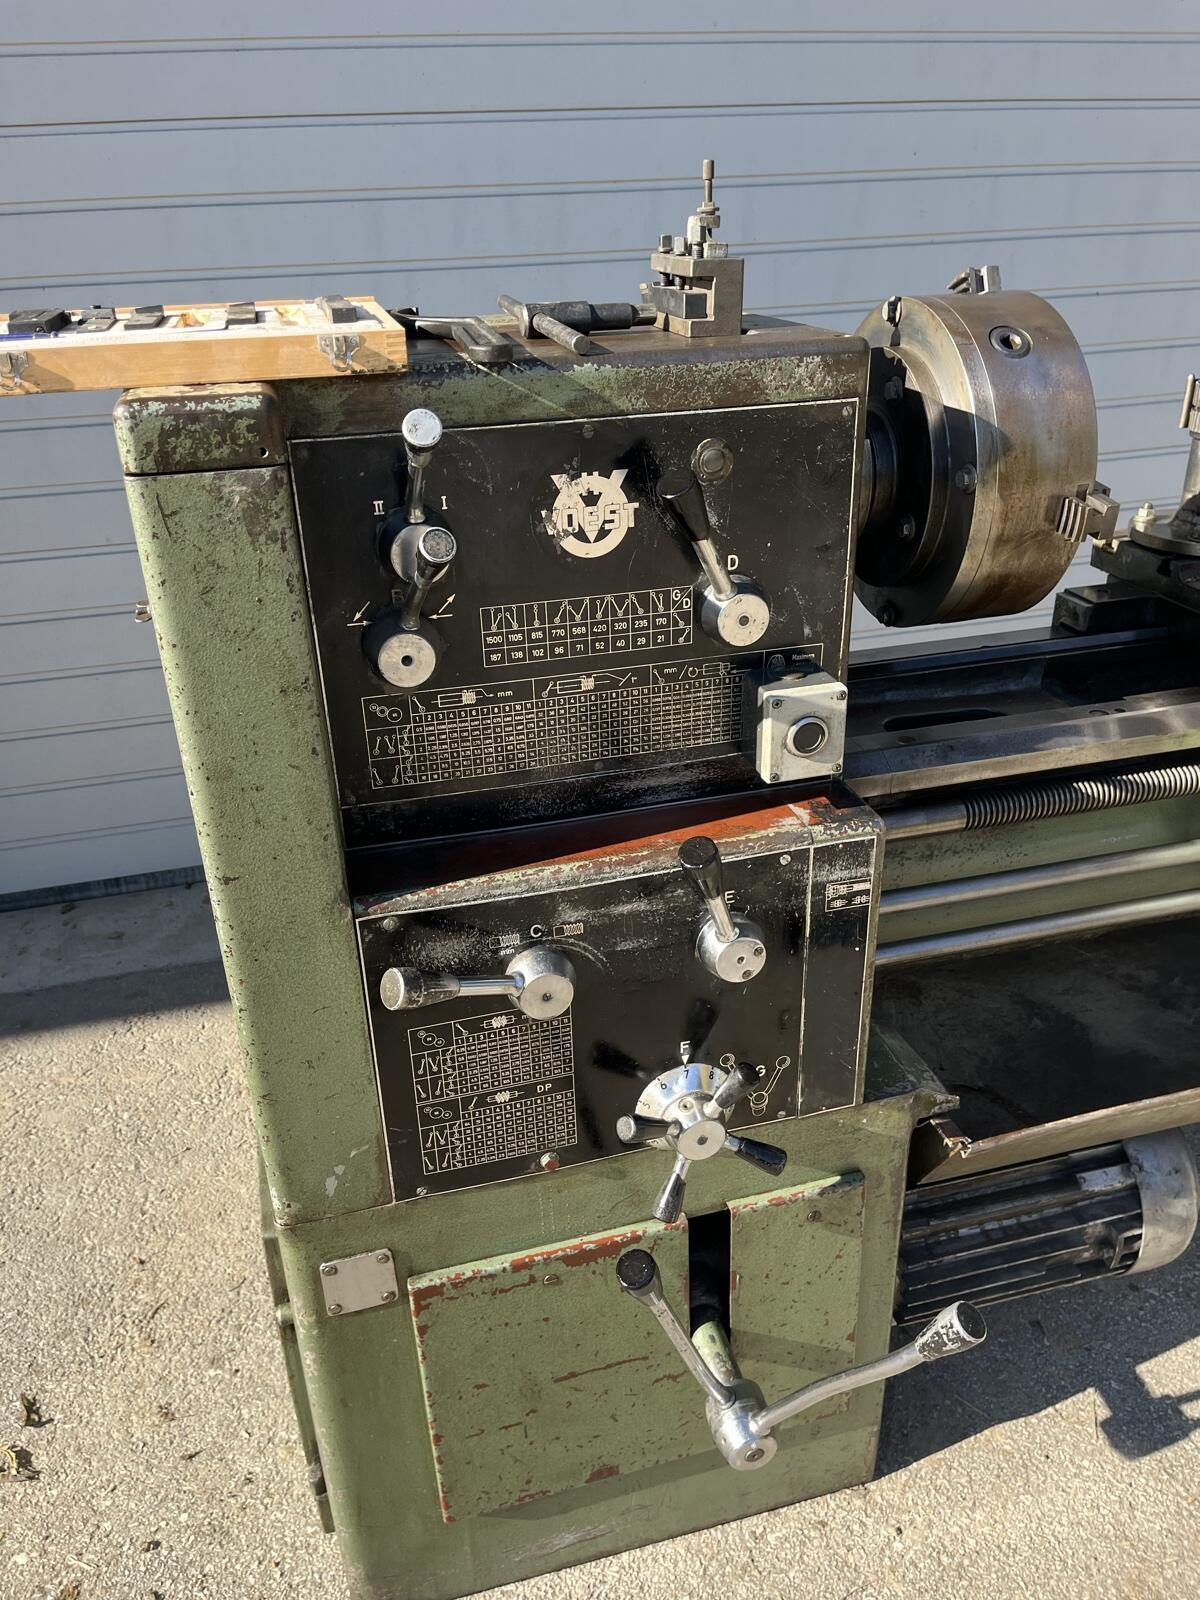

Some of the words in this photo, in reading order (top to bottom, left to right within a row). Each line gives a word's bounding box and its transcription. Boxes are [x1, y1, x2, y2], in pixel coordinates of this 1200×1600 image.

[728, 555, 738, 570] D
[673, 590, 680, 600] G
[683, 599, 690, 608] D
[724, 890, 736, 904] E
[530, 924, 542, 938] C
[680, 1040, 690, 1054] F
[684, 1070, 690, 1079] 7
[709, 1071, 714, 1080] 8
[756, 1064, 766, 1077] G
[536, 1084, 552, 1093] DP
